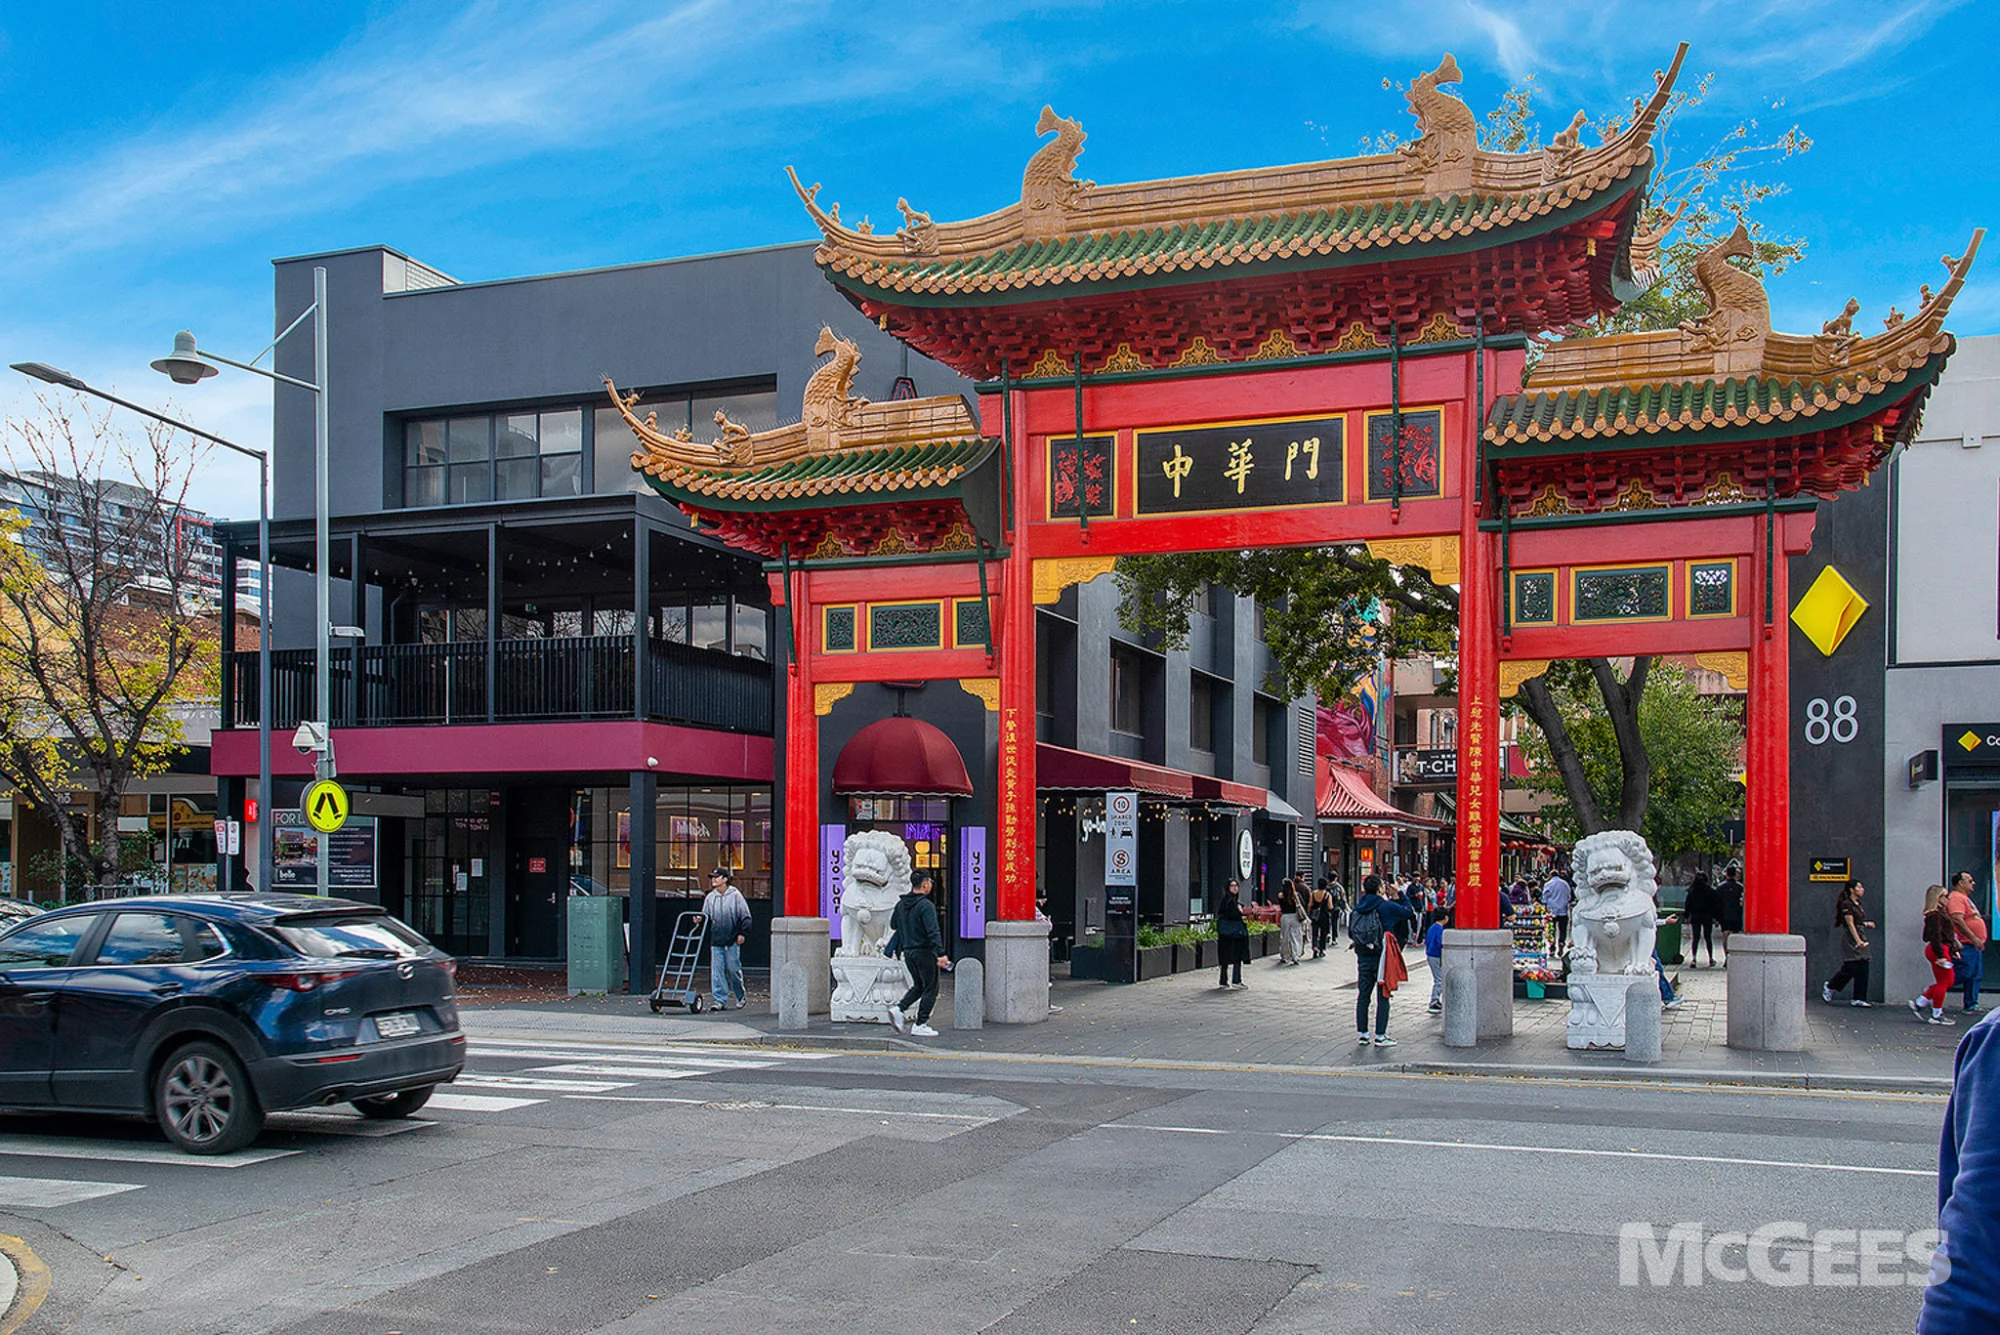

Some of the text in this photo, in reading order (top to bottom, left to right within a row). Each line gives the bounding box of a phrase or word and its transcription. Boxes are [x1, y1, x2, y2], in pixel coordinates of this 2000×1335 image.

[1162, 437, 1321, 498] 中華門
[1804, 695, 1859, 745] 88
[275, 813, 296, 824] FOR
[1117, 801, 1126, 809] 10
[1081, 816, 1106, 842] yo-ba
[971, 851, 981, 913] yo-bar
